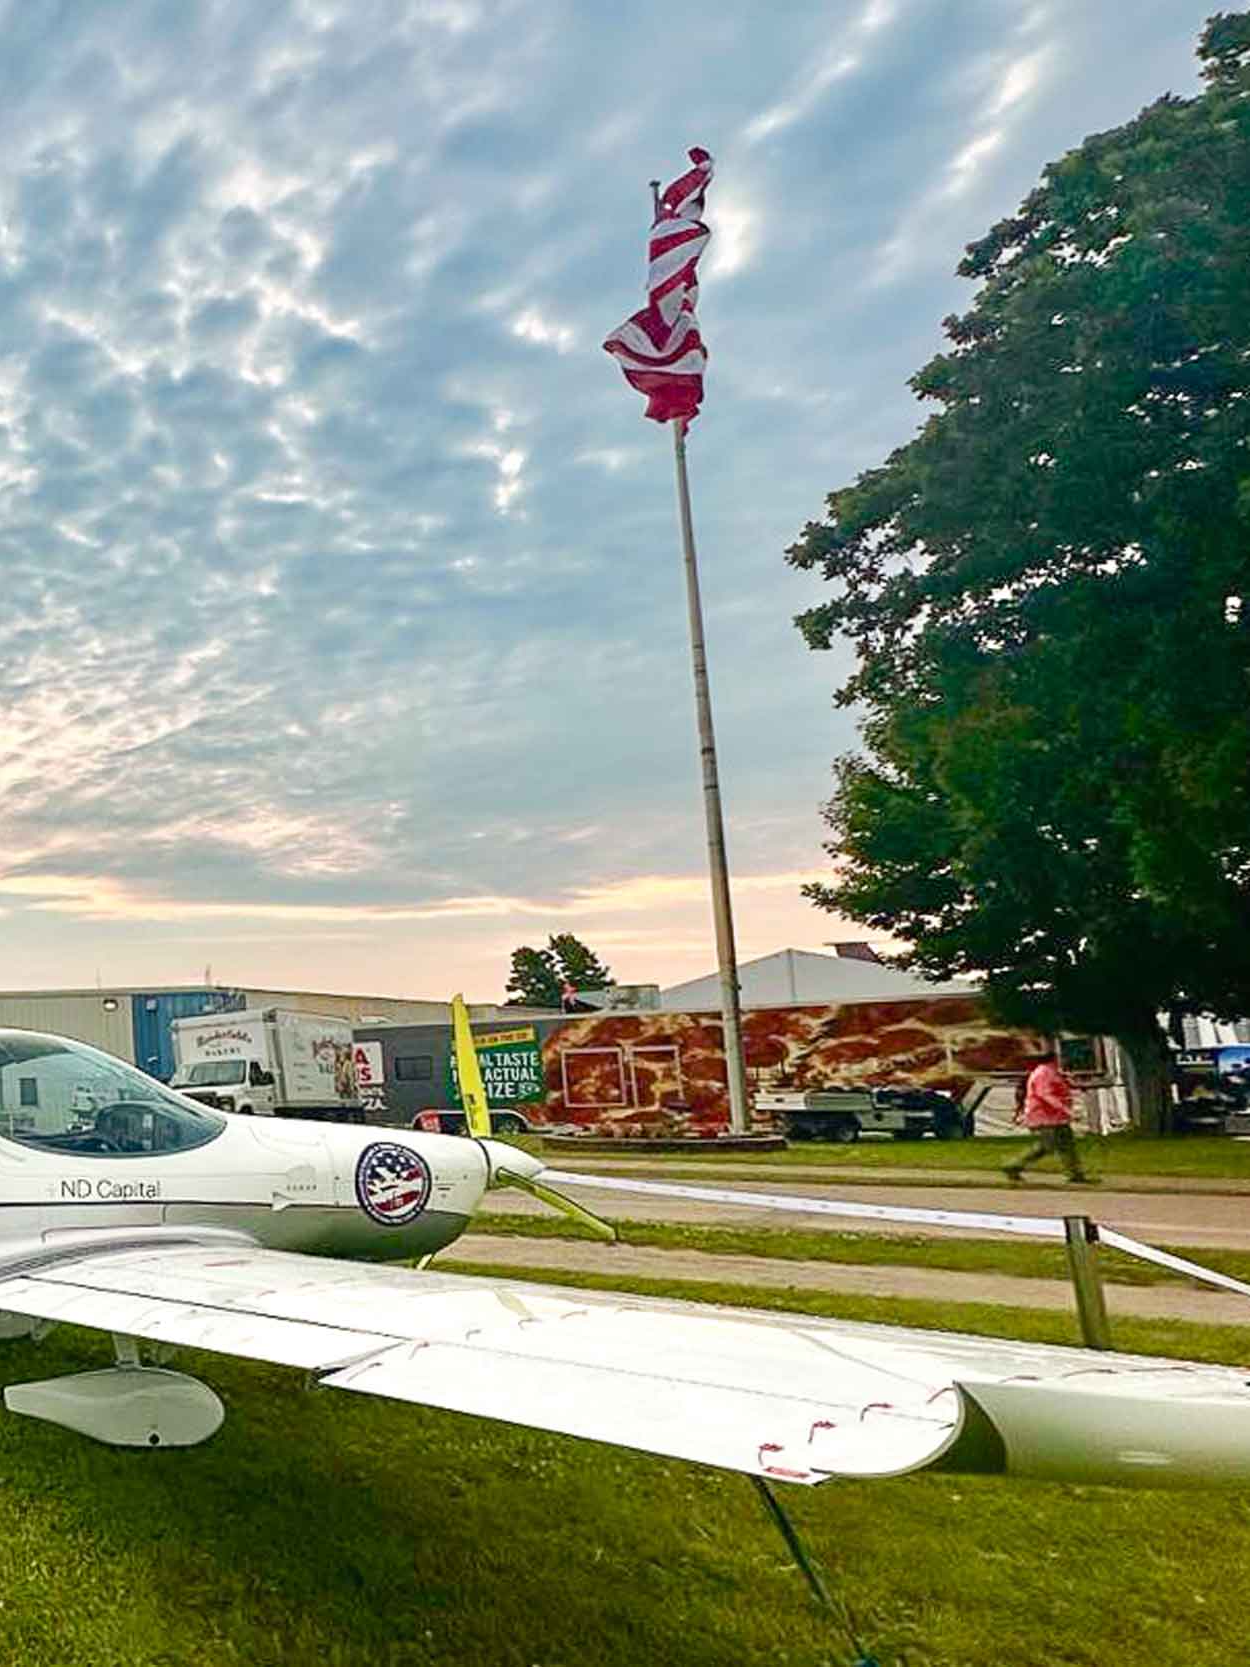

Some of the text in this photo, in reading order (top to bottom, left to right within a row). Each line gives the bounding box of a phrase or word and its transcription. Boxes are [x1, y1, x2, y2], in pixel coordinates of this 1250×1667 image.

[495, 1050, 539, 1067] TASTE
[484, 1066, 538, 1082] ACTUAL
[61, 1179, 161, 1200] ND Capital
